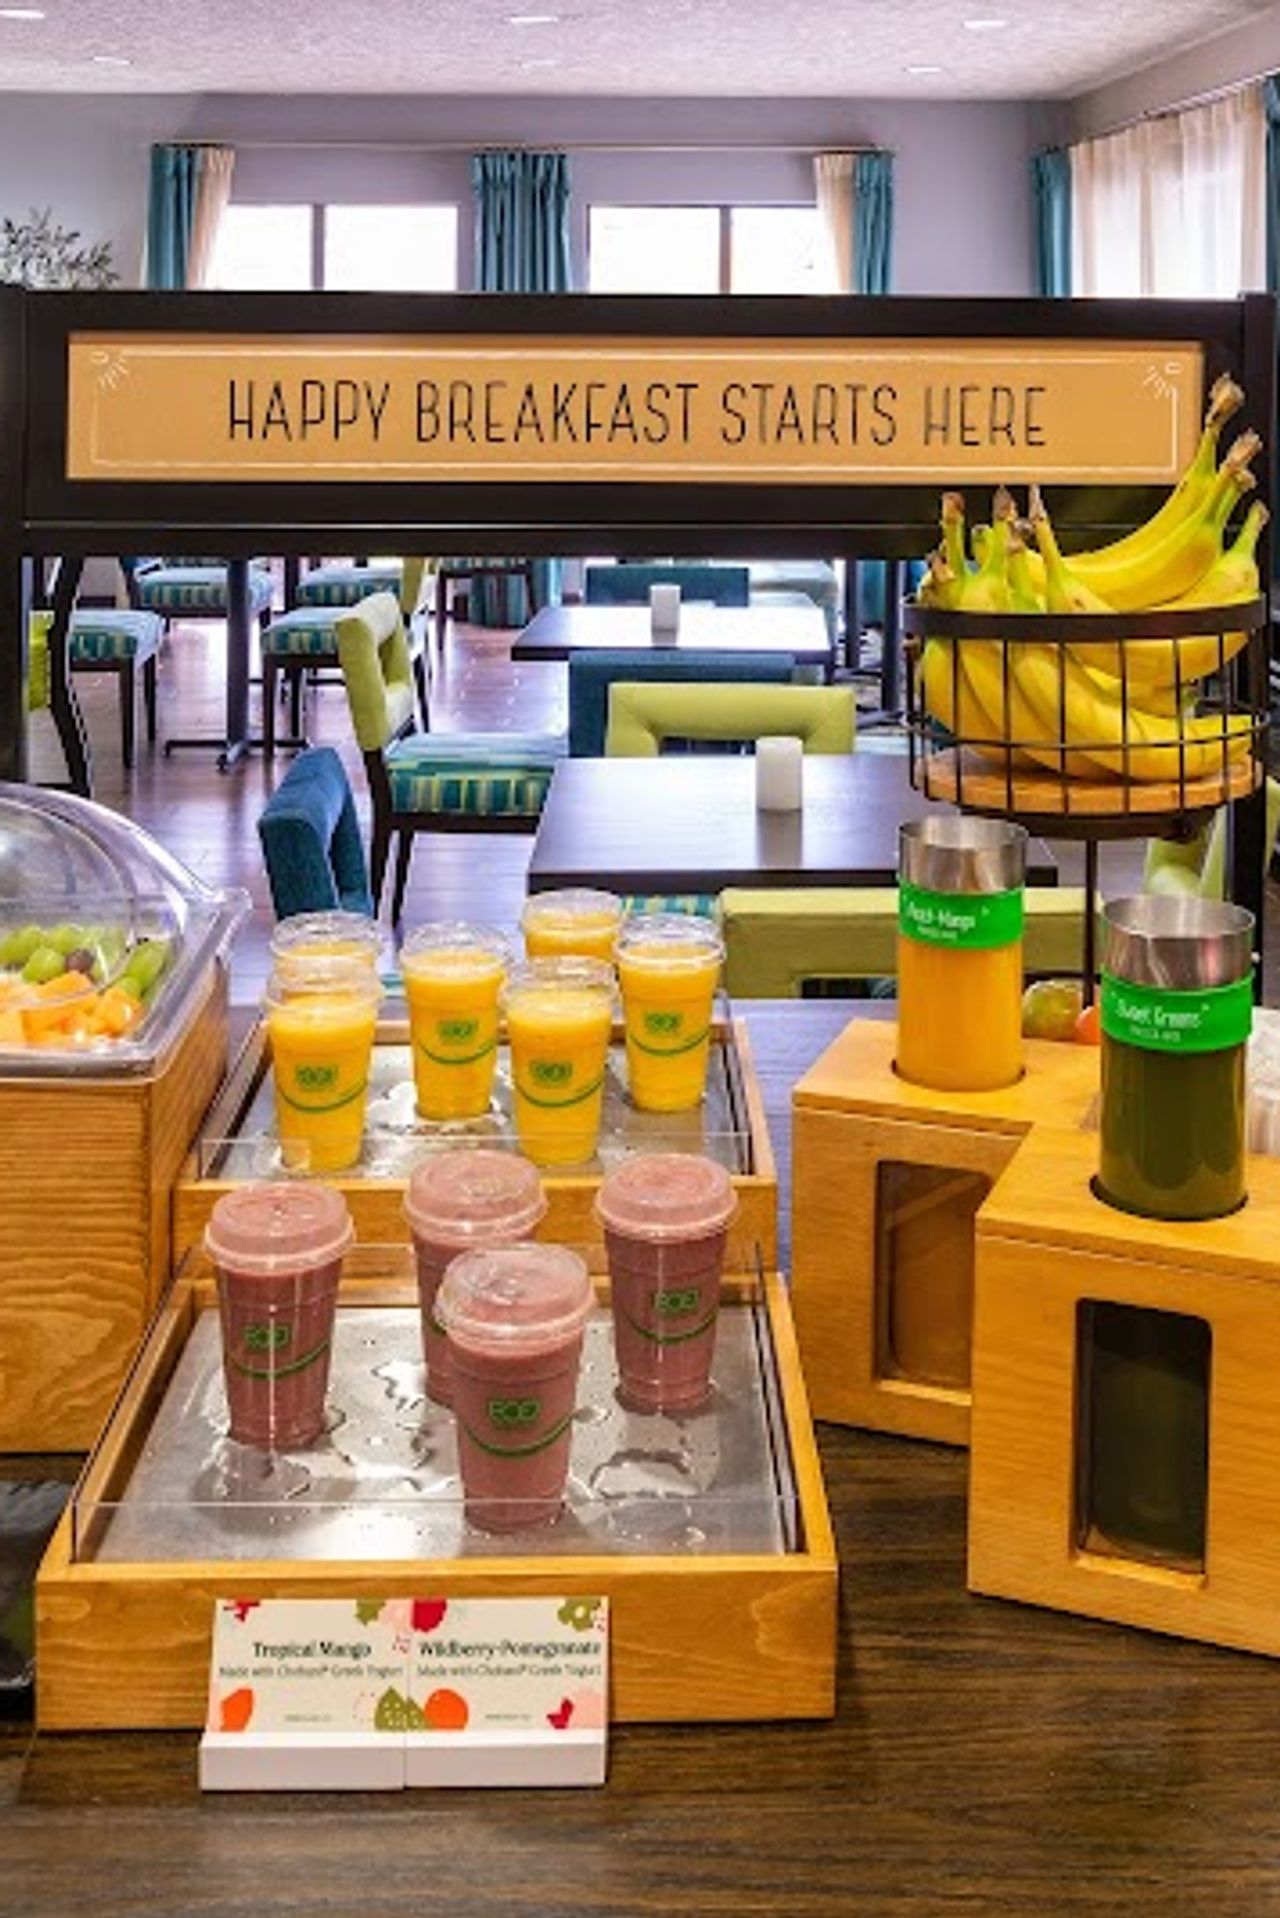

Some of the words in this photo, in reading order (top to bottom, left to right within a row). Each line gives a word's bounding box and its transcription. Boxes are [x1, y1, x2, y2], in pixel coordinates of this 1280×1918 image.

[229, 379, 391, 441] HAPPY
[415, 380, 699, 446] BREAKFAST
[720, 383, 898, 446] STARTS
[923, 386, 1048, 447] HERE
[254, 1640, 314, 1660] Tropical
[318, 1640, 372, 1661] Mango
